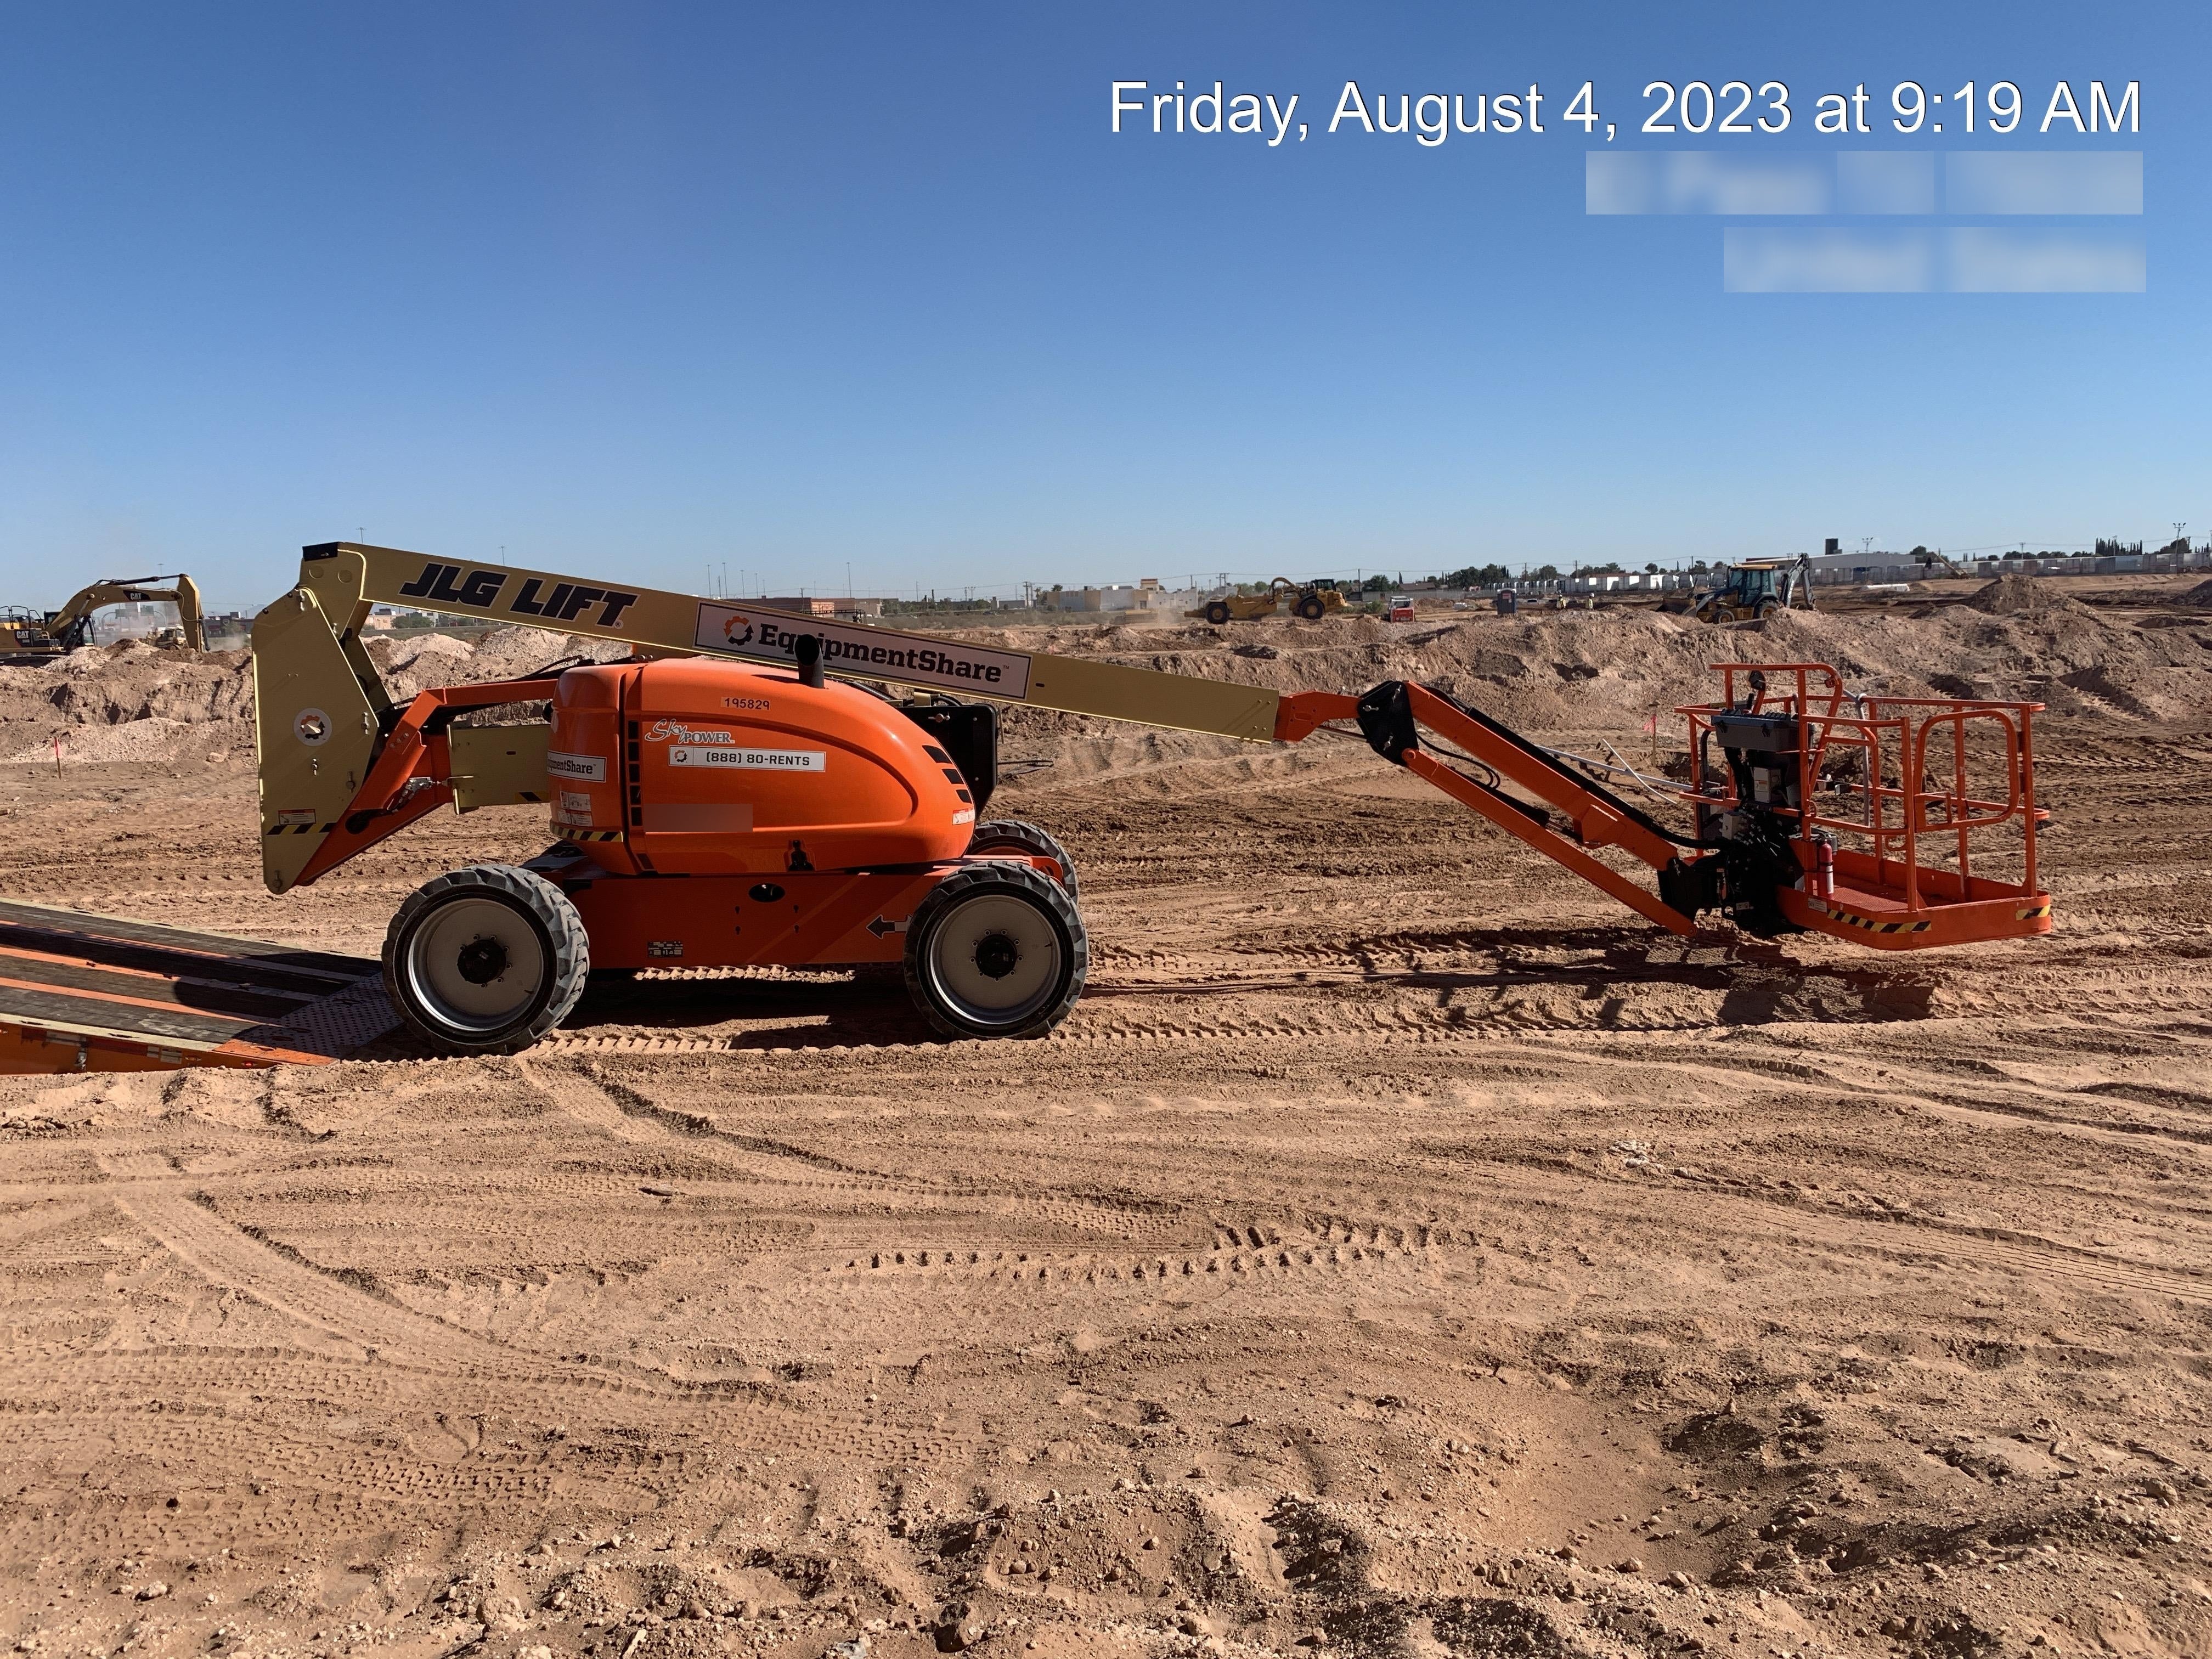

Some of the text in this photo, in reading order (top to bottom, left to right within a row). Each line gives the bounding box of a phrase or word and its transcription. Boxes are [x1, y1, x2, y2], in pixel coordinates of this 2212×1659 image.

[398, 562, 640, 628] JLG LIFT
[16, 630, 29, 639] CAT
[759, 623, 1002, 683] EqipmentShare
[725, 697, 770, 710] 195829
[706, 752, 810, 766] (888) 80-RENTS
